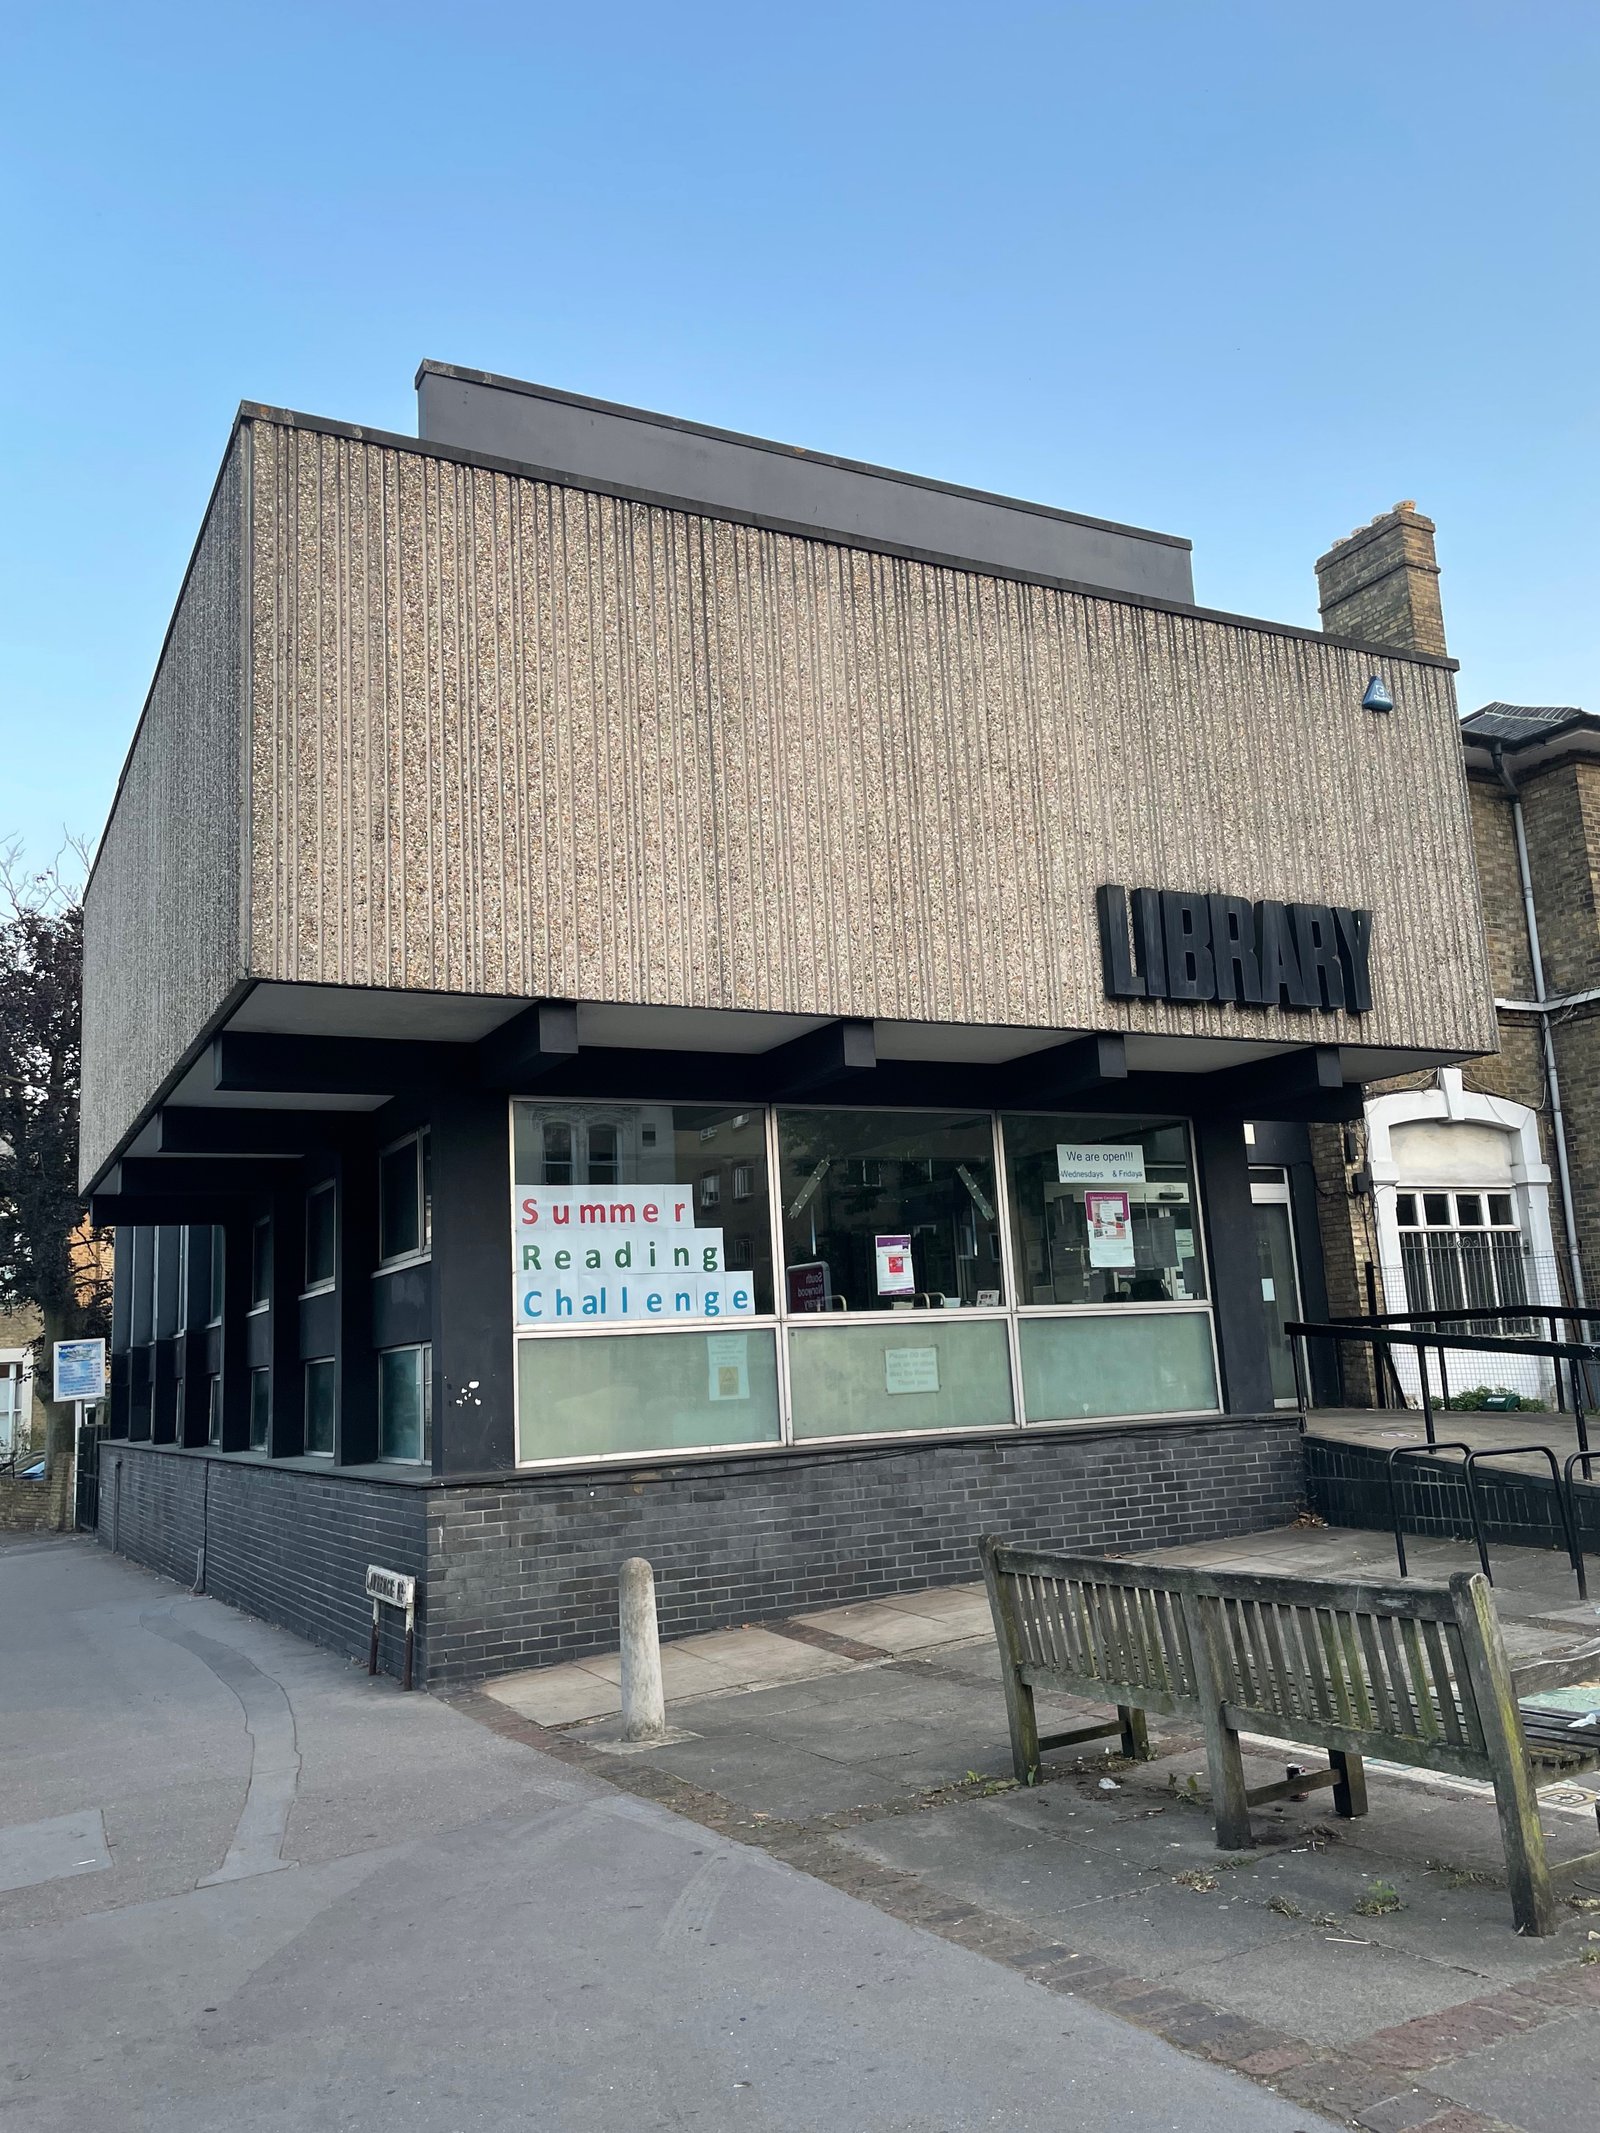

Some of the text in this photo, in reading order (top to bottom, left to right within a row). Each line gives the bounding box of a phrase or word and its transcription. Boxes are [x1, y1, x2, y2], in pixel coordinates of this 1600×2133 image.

[1097, 884, 1373, 1013] LIBRARY
[1066, 1151, 1082, 1161] We
[1102, 1151, 1133, 1163] open!!!
[1060, 1169, 1142, 1179] Wednesdays & Fridays
[522, 1198, 686, 1225] Summer
[522, 1241, 718, 1272] Reading
[523, 1286, 748, 1317] Challenge
